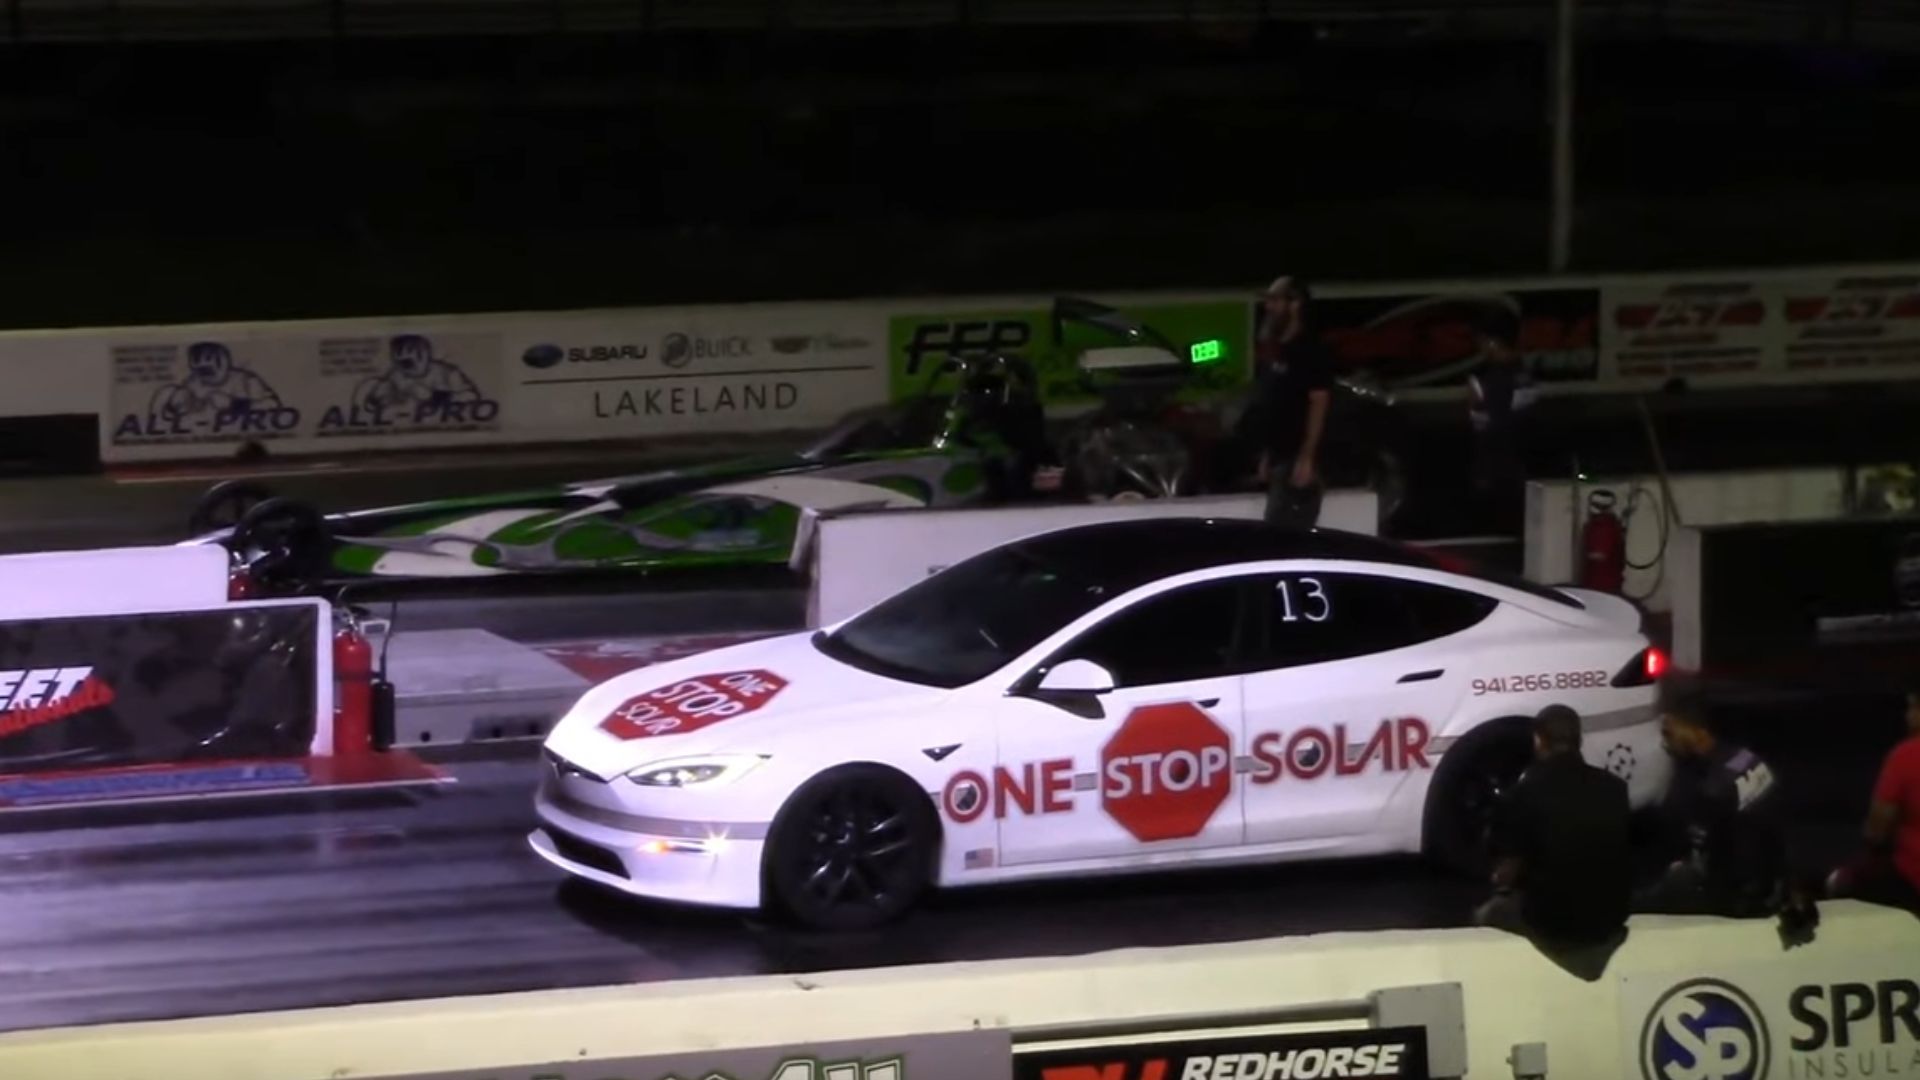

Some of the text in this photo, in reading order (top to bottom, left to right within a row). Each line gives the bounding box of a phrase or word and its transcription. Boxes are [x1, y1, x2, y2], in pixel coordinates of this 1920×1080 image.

[568, 345, 647, 363] SUBARU
[317, 400, 497, 431] ALL-PRO
[593, 383, 799, 418] LAKELAND
[114, 407, 300, 438] ALL-PRO
[1276, 577, 1331, 624] 13
[651, 681, 745, 718] STOP
[720, 673, 778, 697] ONE
[1471, 670, 1608, 696] 941.266.8882
[943, 716, 1432, 824] ONE STOP SOLAR
[1788, 979, 1920, 1052] SPR
[1181, 1044, 1405, 1080] REDHORSE
